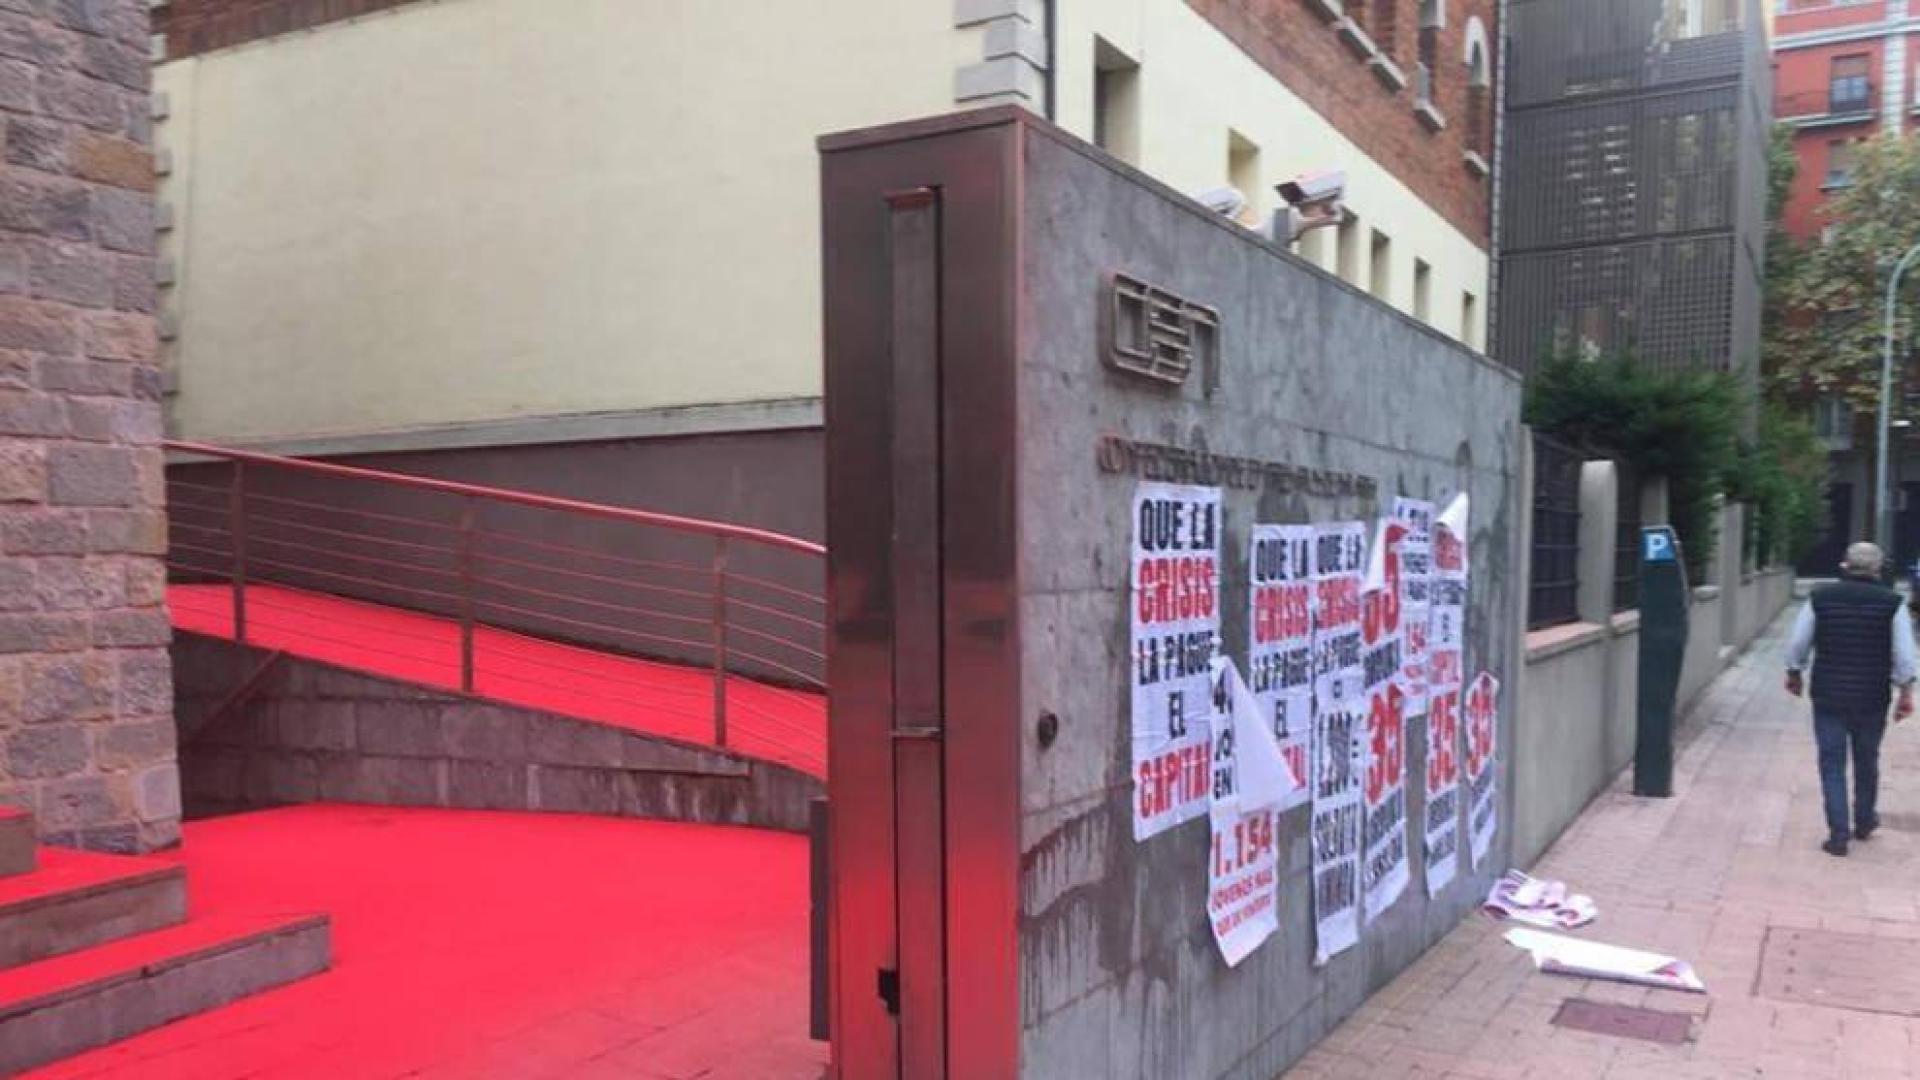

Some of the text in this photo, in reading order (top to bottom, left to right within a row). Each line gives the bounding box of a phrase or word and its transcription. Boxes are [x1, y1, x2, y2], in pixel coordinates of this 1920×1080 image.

[1140, 499, 1215, 551] QUE LA
[1647, 533, 1668, 560] P
[1256, 538, 1308, 581] QUE LA
[1140, 556, 1215, 624] CRISIS
[1256, 583, 1309, 644] CRISIS
[1139, 631, 1213, 686] LA PAGUE
[1169, 688, 1187, 739] EL
[1274, 699, 1289, 740] EL
[1215, 808, 1273, 878] 1.154
